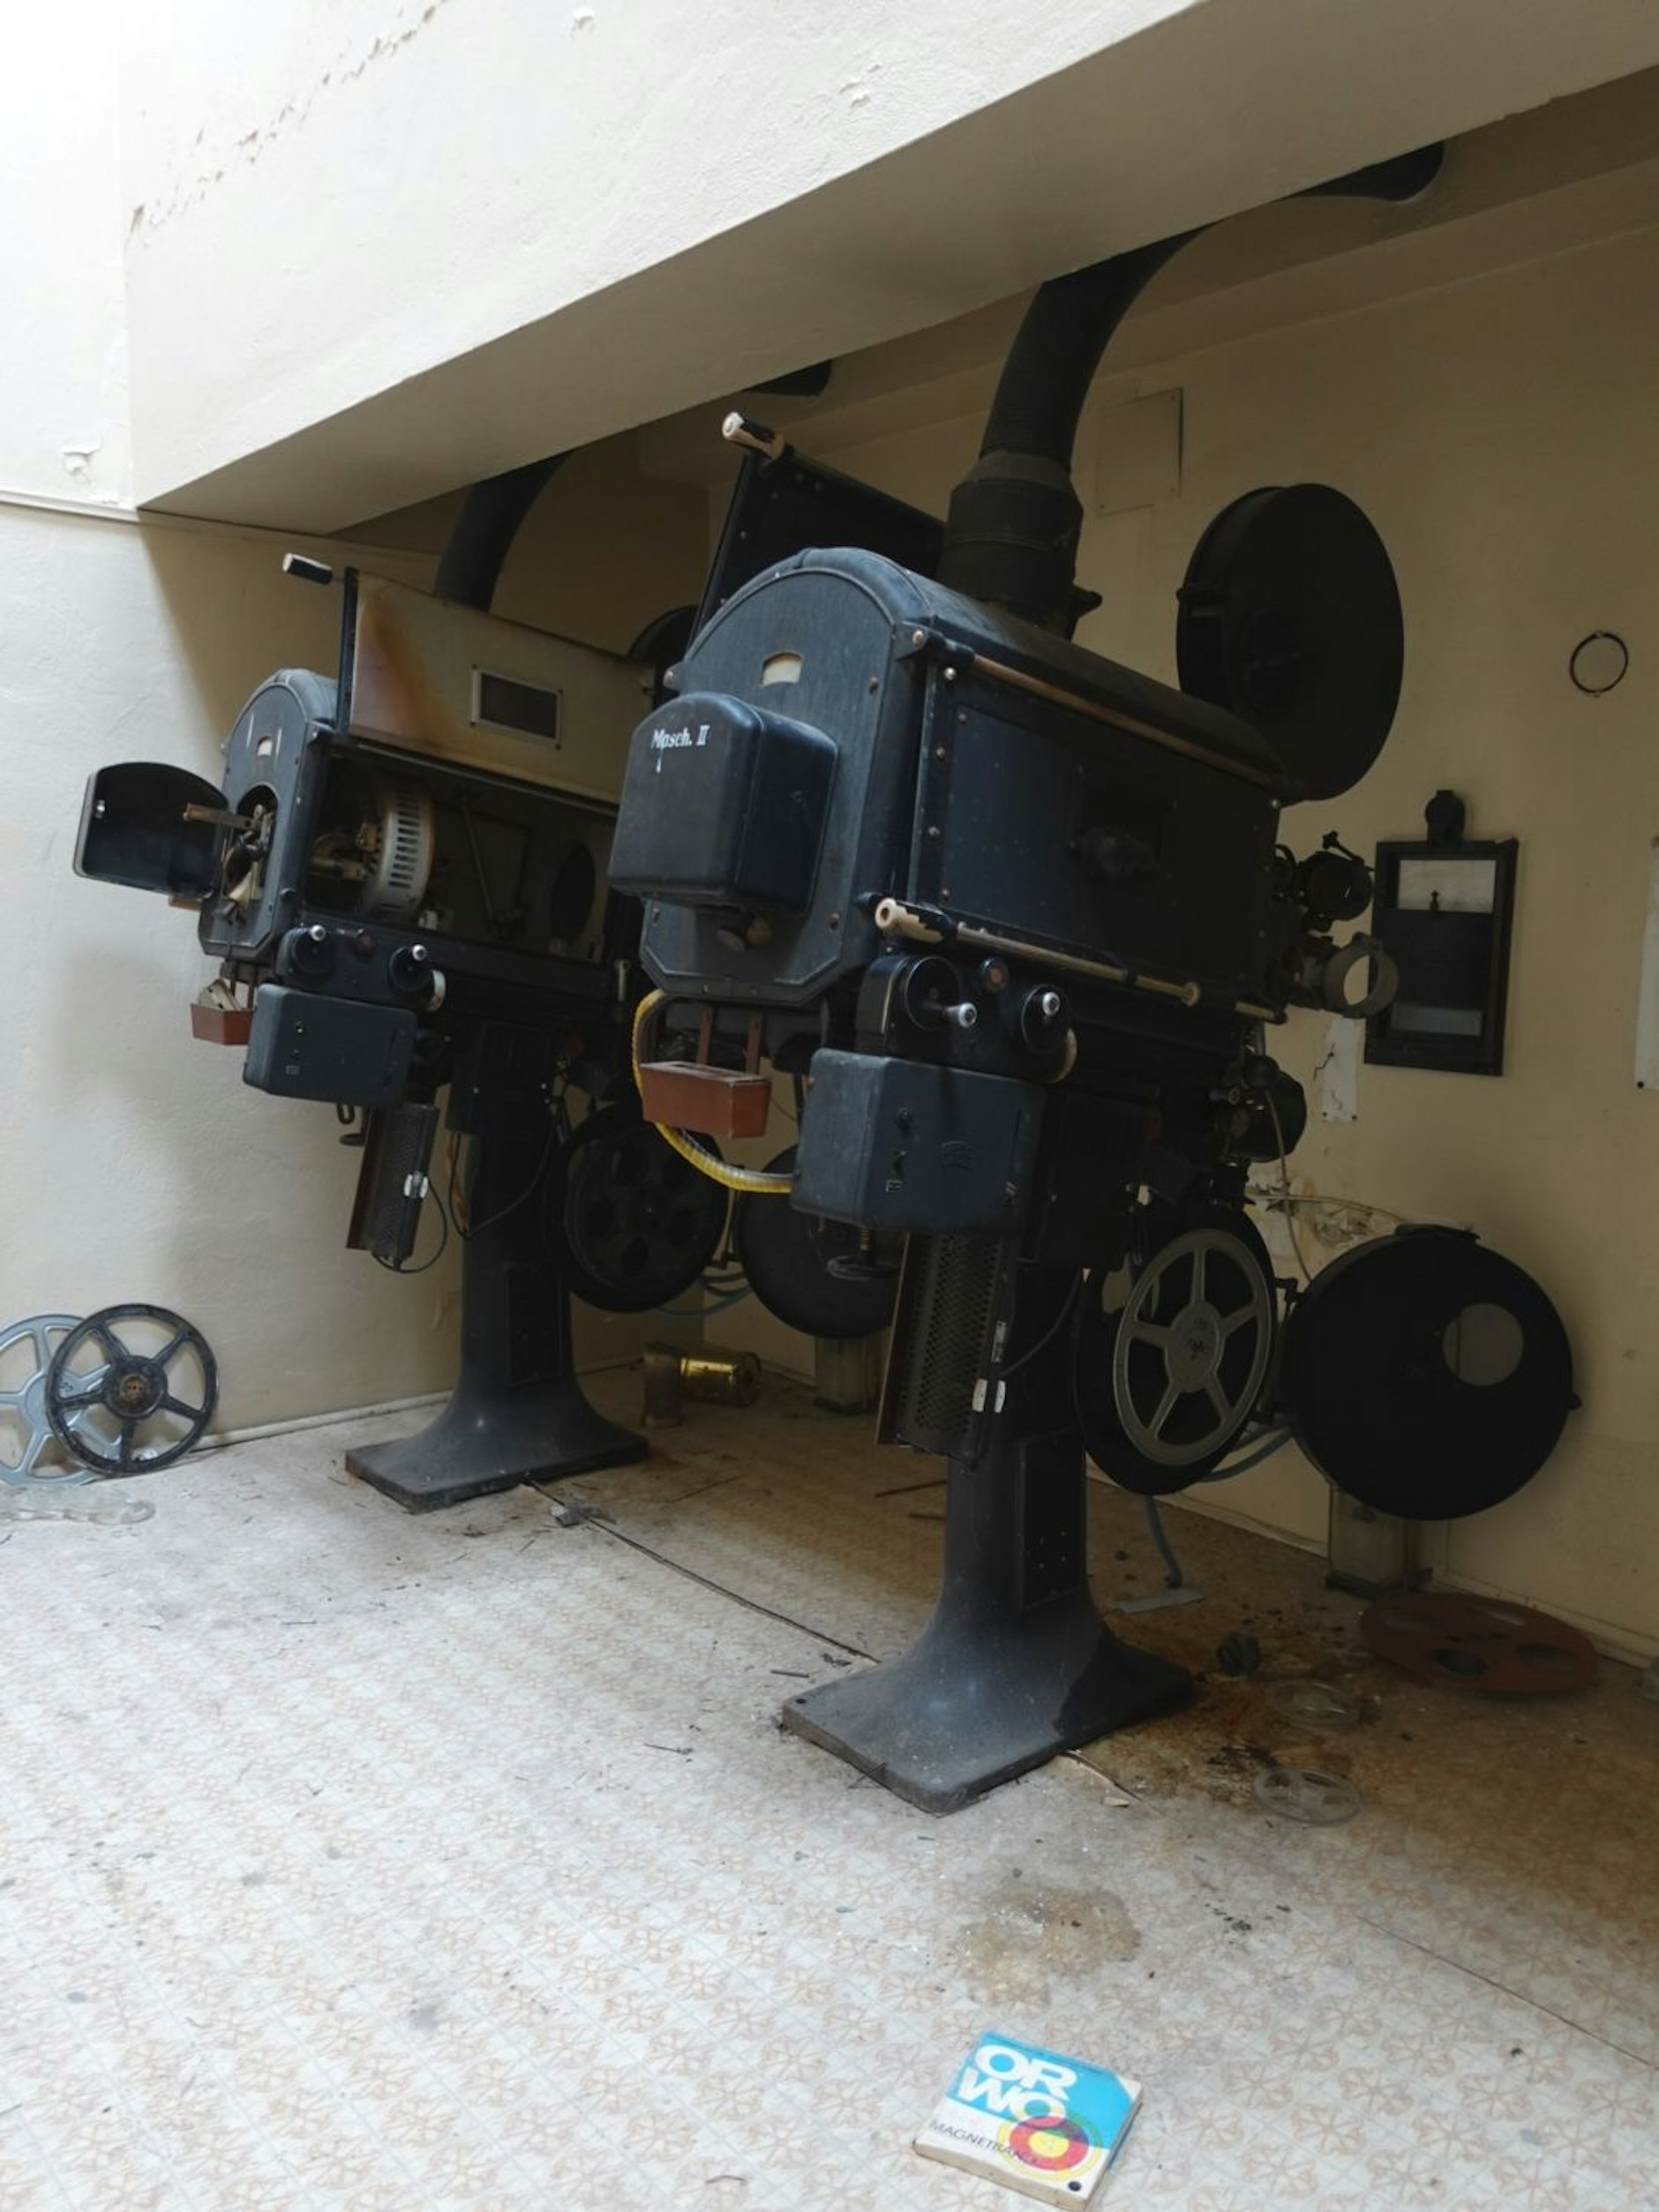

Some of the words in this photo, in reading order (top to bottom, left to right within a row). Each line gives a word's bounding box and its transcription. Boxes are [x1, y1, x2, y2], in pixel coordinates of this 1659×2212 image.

[695, 724, 710, 746] II
[957, 2067, 1067, 2127] WO
[974, 2044, 1077, 2101] OR
